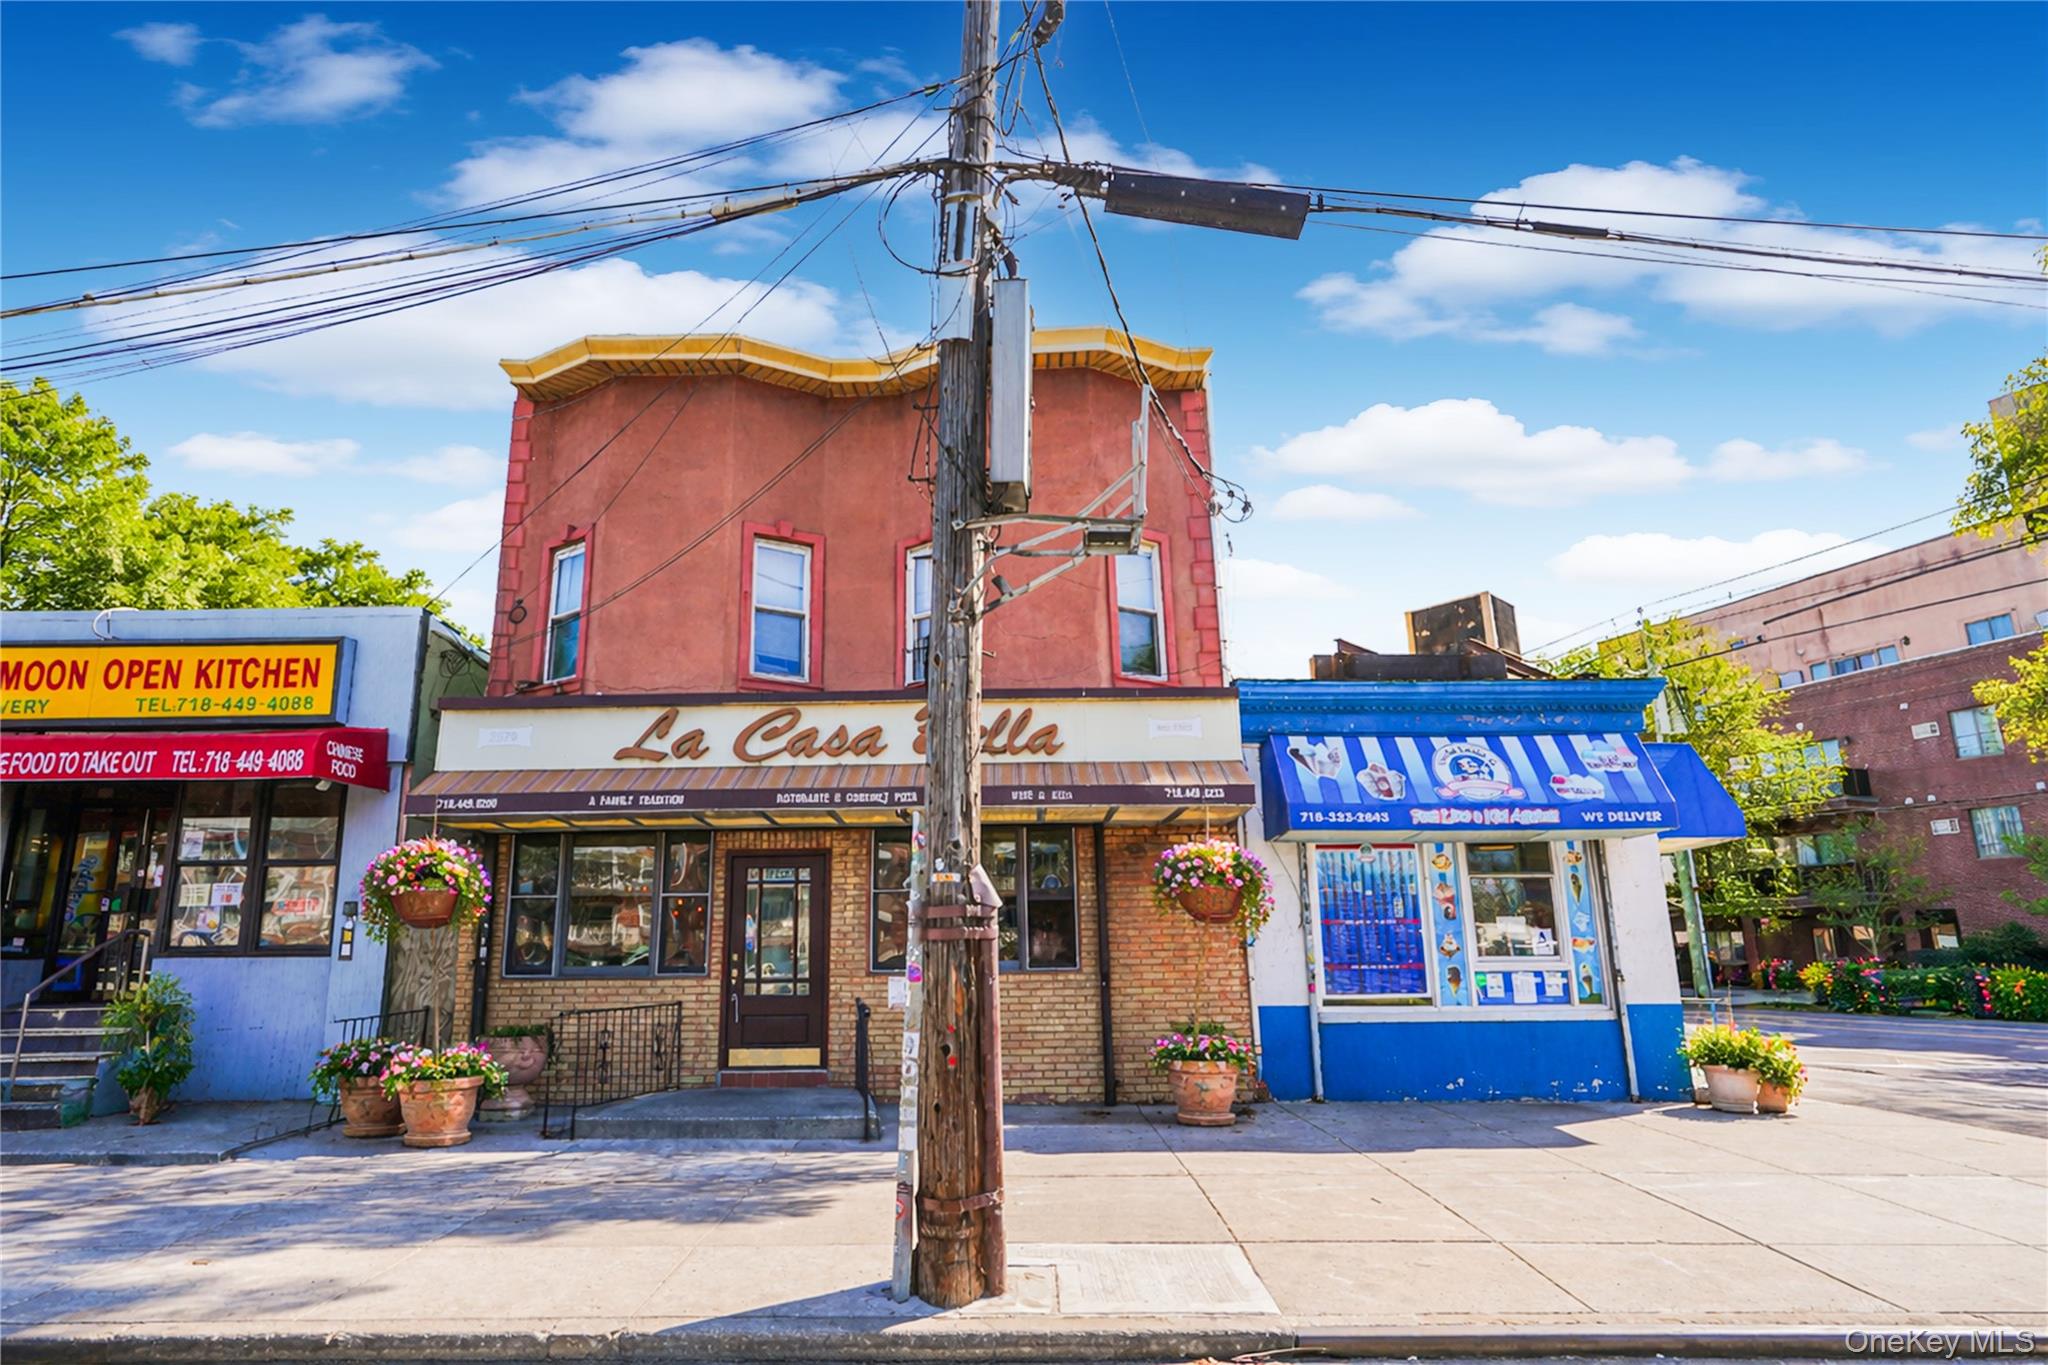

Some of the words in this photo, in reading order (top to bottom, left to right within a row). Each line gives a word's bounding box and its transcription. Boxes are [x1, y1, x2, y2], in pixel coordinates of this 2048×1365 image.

[0, 659, 89, 692] MOON
[102, 658, 183, 691] OPEN
[194, 657, 321, 690] KITCHEN
[613, 706, 710, 762] La
[732, 707, 888, 763] Casa
[8, 751, 56, 775] FOOD
[58, 751, 80, 775] TO
[81, 750, 122, 775] TAKE
[121, 750, 157, 774] OUT
[331, 758, 357, 779] FOOD
[1581, 811, 1604, 822] WE
[1607, 811, 1663, 823] DELIVER
